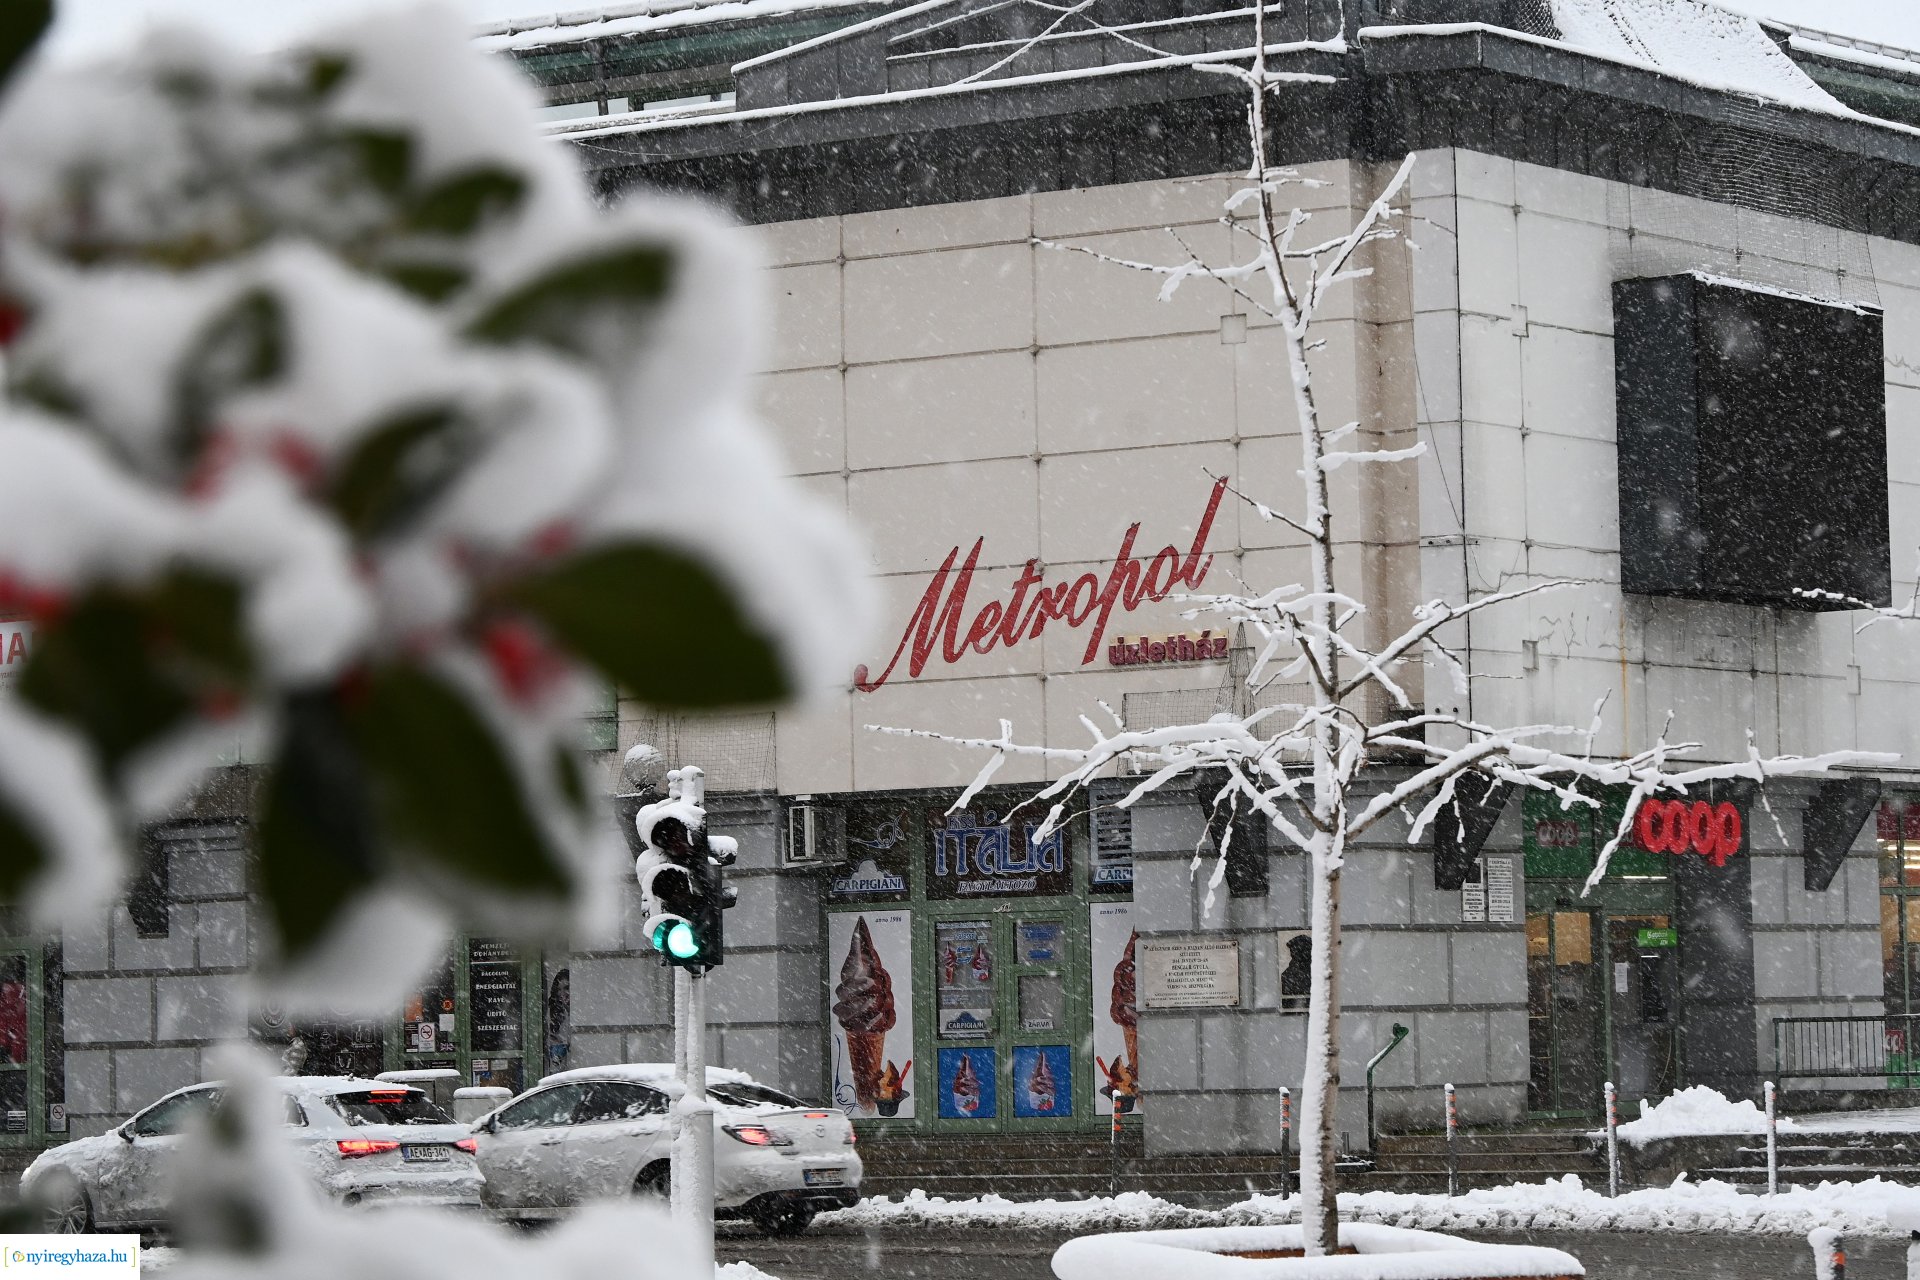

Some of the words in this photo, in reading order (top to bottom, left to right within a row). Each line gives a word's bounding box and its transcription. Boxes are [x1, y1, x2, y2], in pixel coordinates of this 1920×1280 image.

[854, 475, 1229, 692] Metropol
[1108, 630, 1228, 666] üzletház
[836, 878, 901, 891] CARPIGIANI
